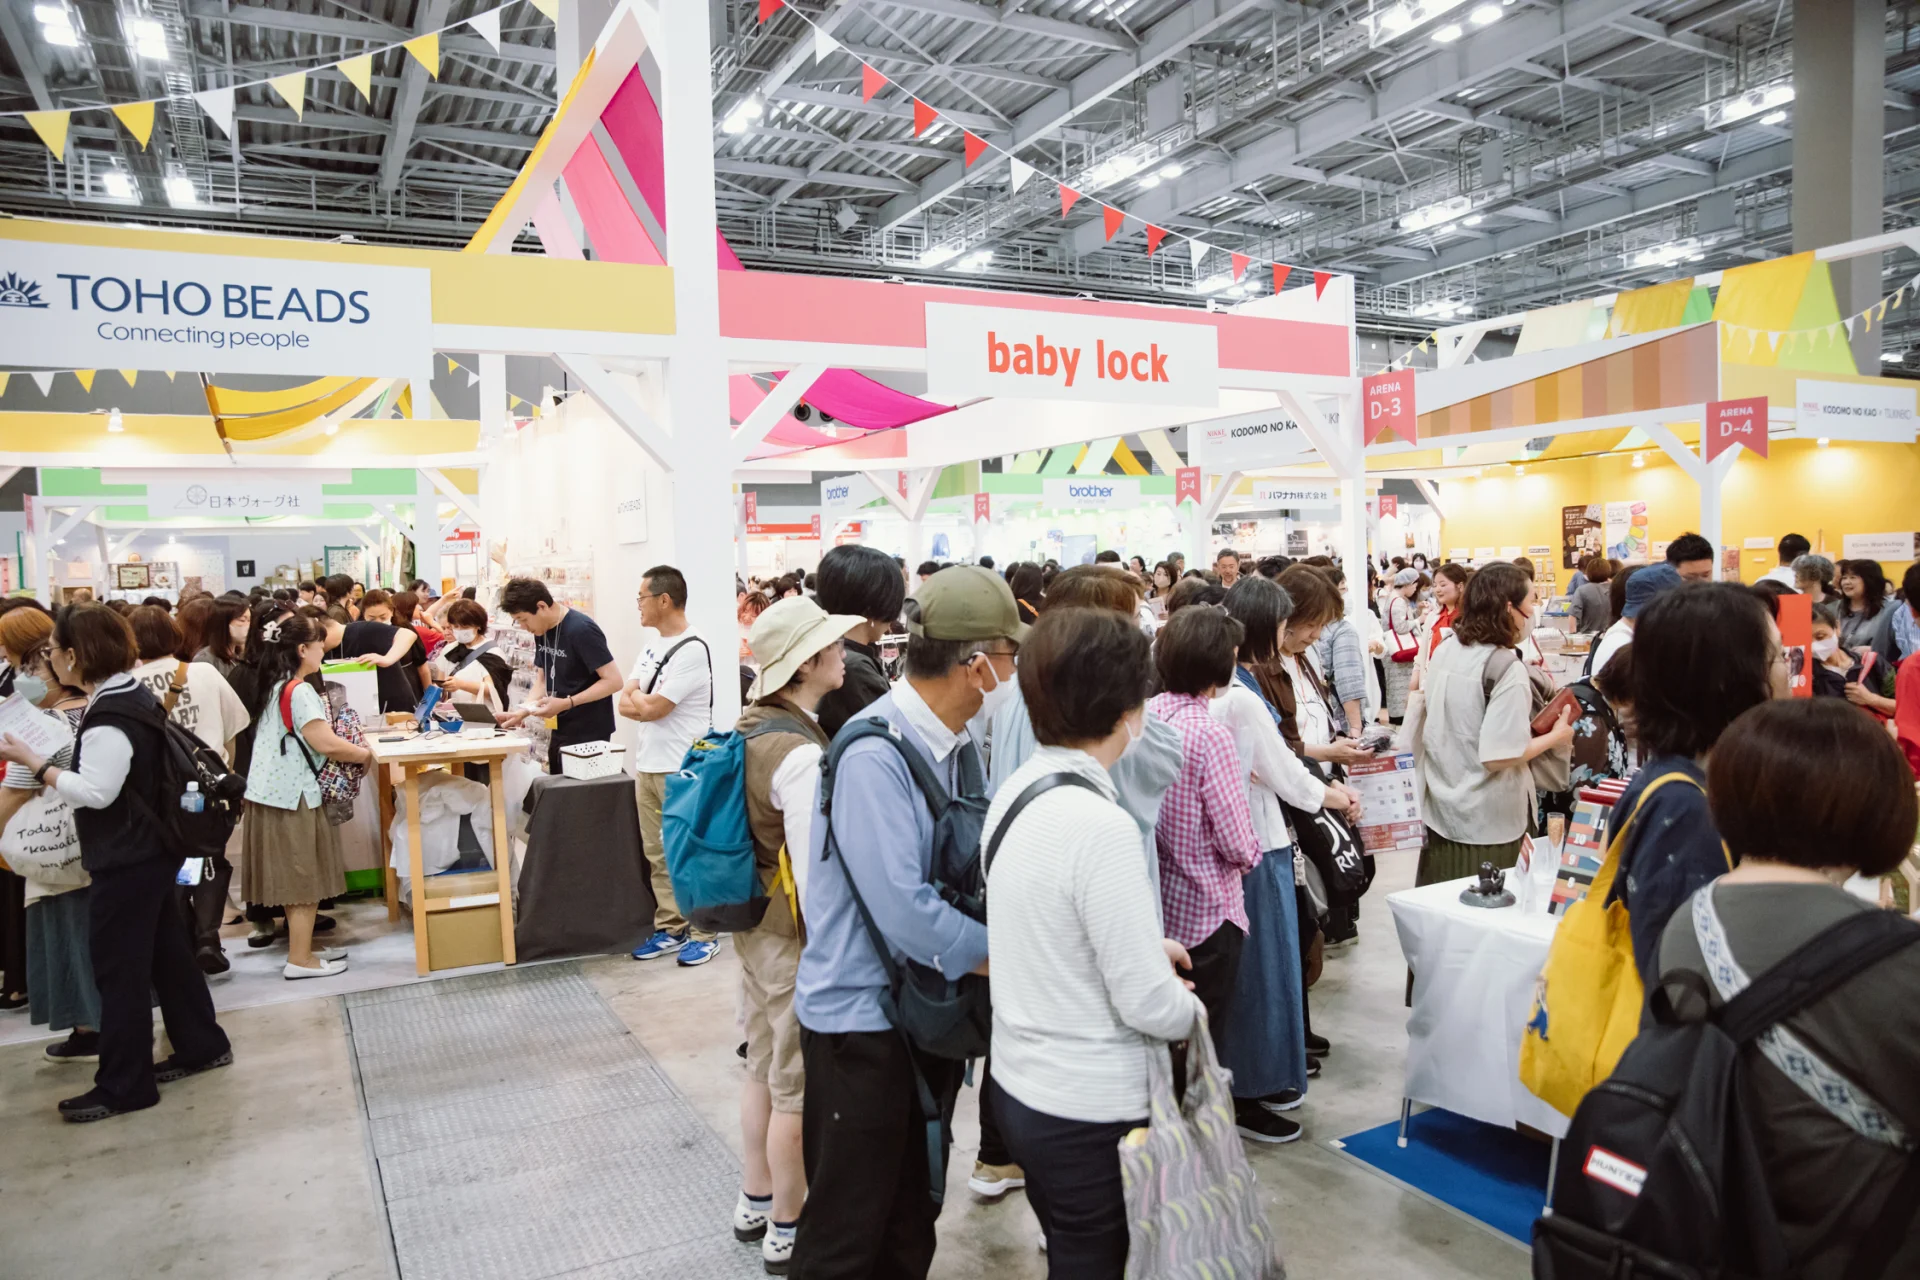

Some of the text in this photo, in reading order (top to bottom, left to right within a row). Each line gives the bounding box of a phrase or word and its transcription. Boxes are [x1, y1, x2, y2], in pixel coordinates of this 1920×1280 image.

[57, 273, 370, 324] TOHO BEADS
[97, 322, 310, 350] Connecting people
[988, 331, 1170, 387] baby lock
[1370, 382, 1401, 396] ARENA
[1371, 397, 1401, 420] D-3
[1720, 407, 1753, 417] ARENA
[1823, 405, 1851, 415] KODOMO
[1231, 424, 1268, 438] KODOMO
[1270, 422, 1284, 433] NO
[1720, 420, 1753, 437] D-4
[1069, 485, 1113, 497] brother
[1181, 480, 1195, 490] D-4
[210, 494, 300, 508] 日本ヴォーグ社
[1268, 491, 1327, 500] ハマナカ株式会社
[141, 669, 178, 692] GOO
[17, 819, 68, 839] Today's
[1592, 816, 1605, 830] 11
[1574, 834, 1587, 845] 10
[1335, 843, 1361, 873] RM
[1568, 854, 1576, 866] 9
